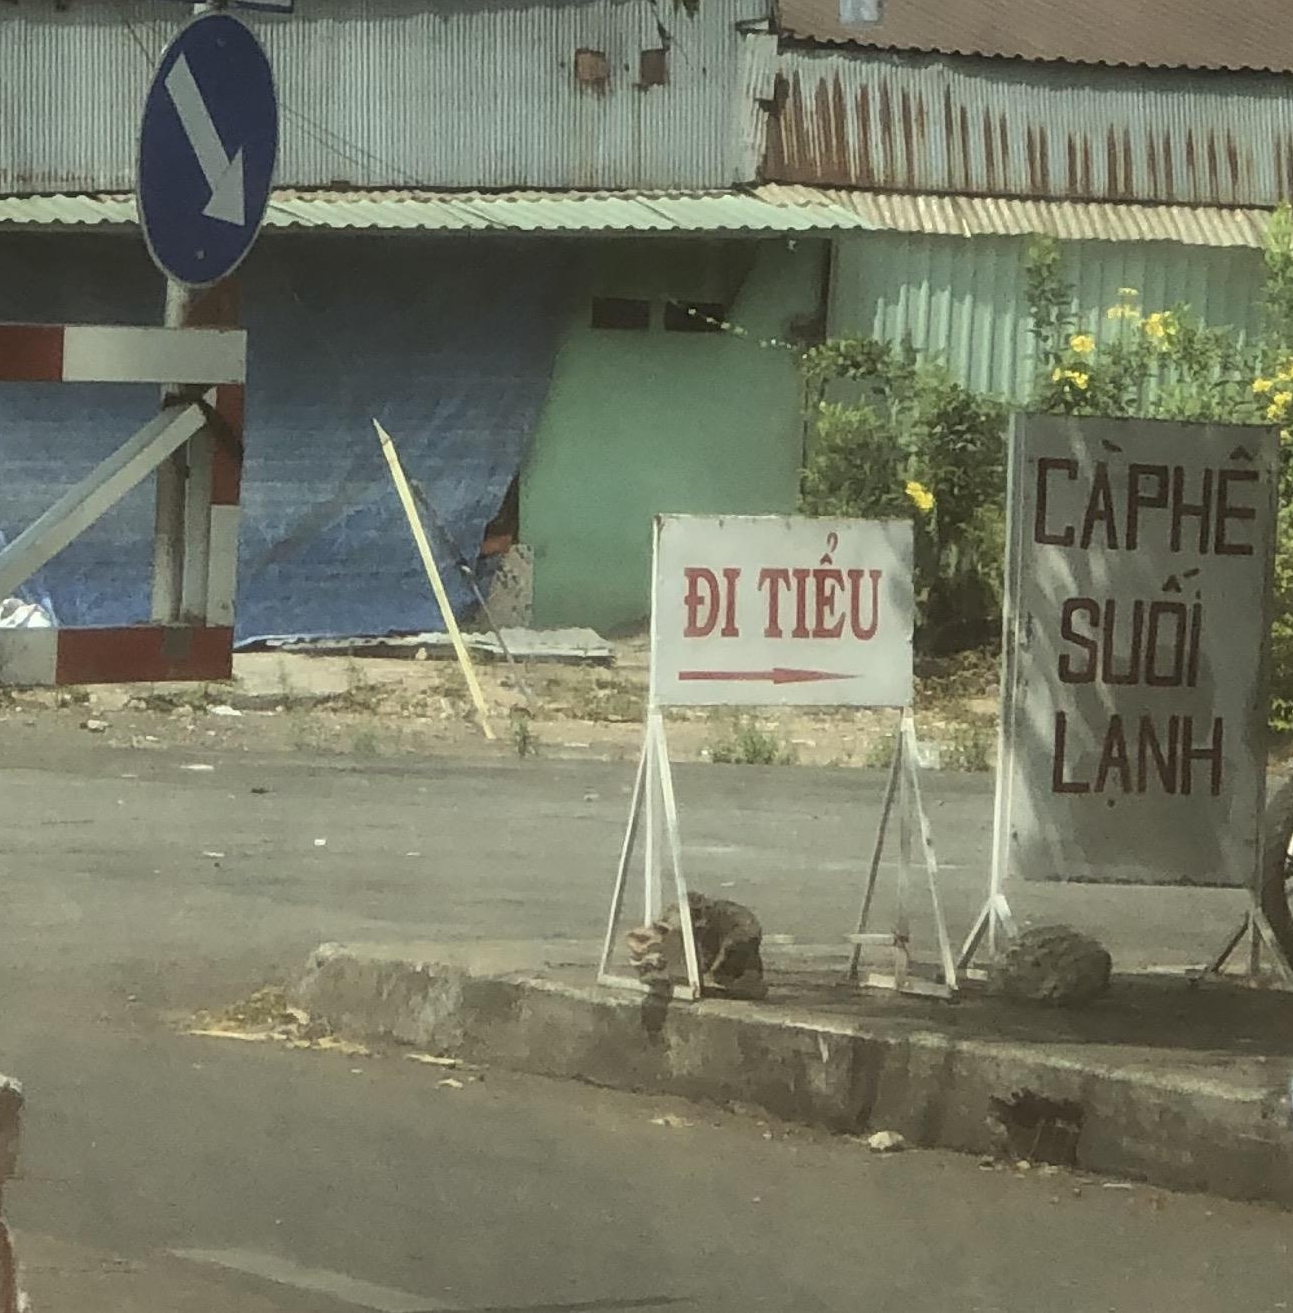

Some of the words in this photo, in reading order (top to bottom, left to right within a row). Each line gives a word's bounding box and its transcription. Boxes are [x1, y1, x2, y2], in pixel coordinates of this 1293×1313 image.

[683, 567, 742, 638] ĐI
[758, 532, 883, 641] TIỂU
[1058, 568, 1203, 688] SUỐI
[1052, 711, 1224, 808] LẠNH
